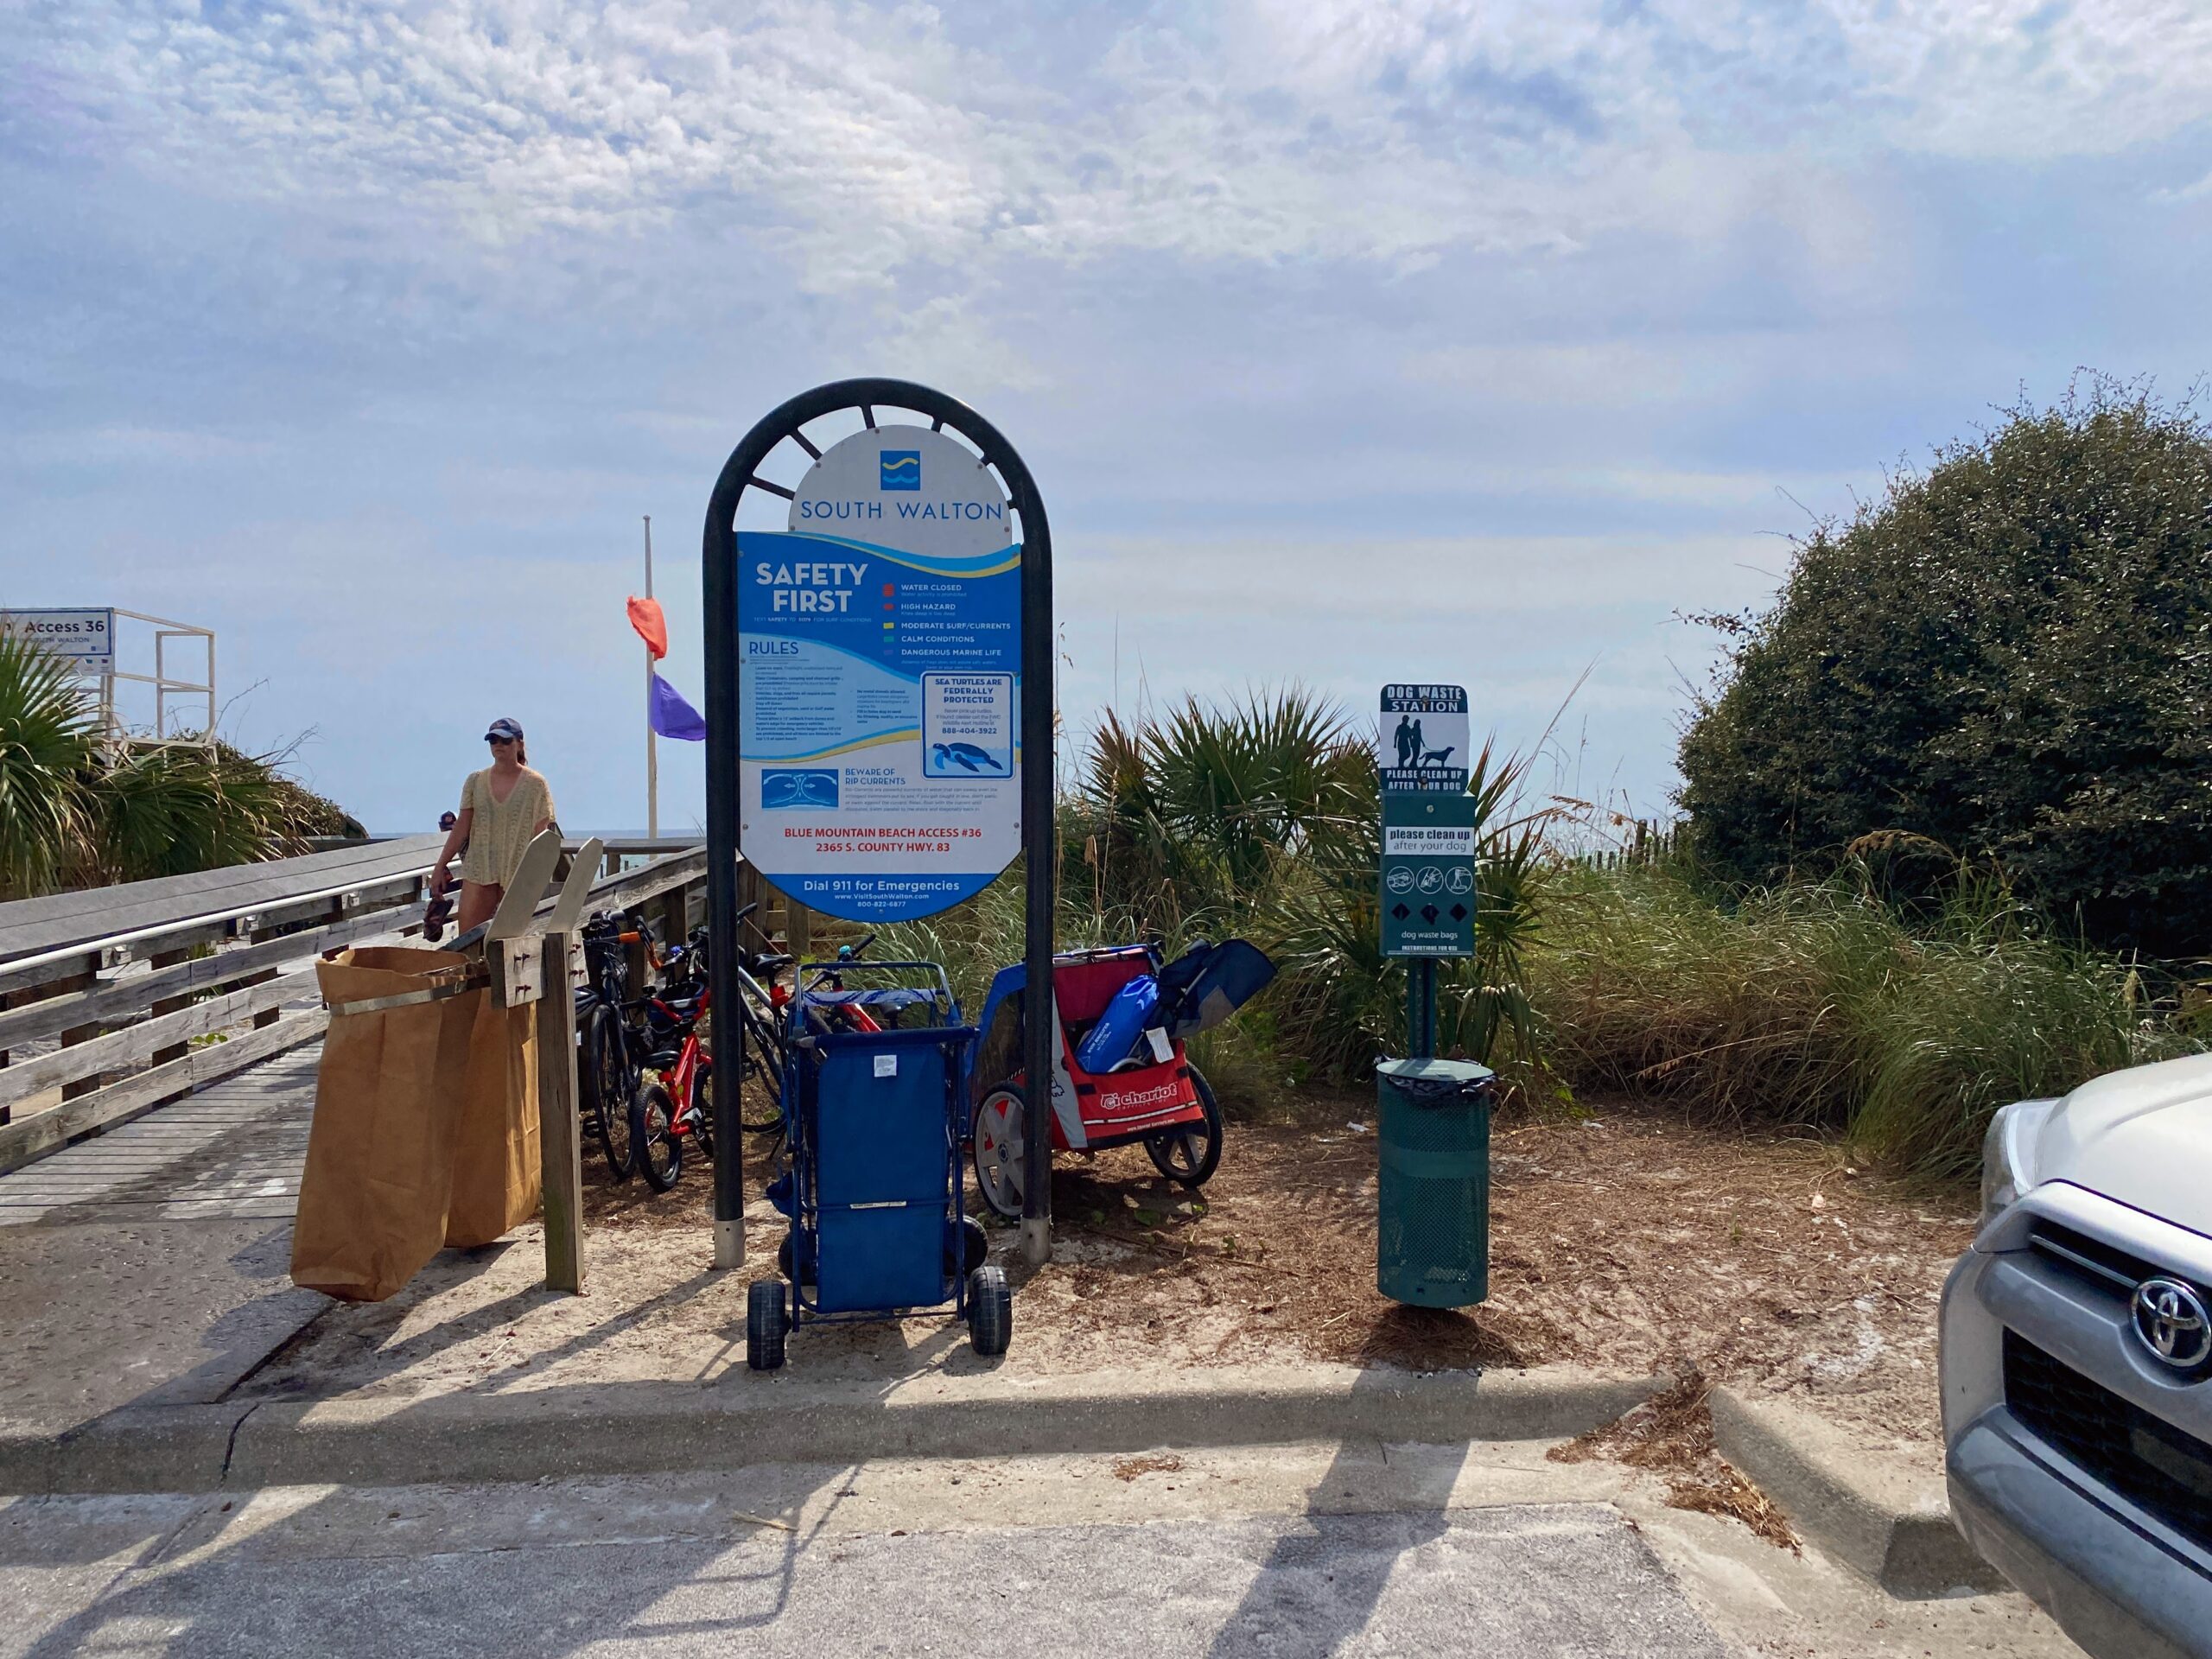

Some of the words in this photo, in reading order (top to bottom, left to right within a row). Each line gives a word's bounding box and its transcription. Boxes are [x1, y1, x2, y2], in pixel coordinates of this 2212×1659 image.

[801, 501, 881, 518] SOUTH
[897, 502, 1001, 519] WALTON
[756, 563, 868, 585] SAFETY
[774, 590, 852, 612] FIRST
[25, 622, 79, 632] Access
[86, 620, 105, 632] 36
[750, 642, 798, 654] RULES
[1388, 686, 1413, 698] DOG
[1419, 687, 1461, 700] WASTE
[1392, 701, 1458, 712] STATION
[1389, 781, 1414, 790] AFTER
[962, 829, 982, 837] #36
[1390, 830, 1424, 840] please
[1427, 830, 1454, 839] clean
[1458, 831, 1470, 840] up
[1394, 841, 1417, 849] after
[1421, 842, 1443, 852] your
[1446, 841, 1466, 852] dog
[804, 880, 828, 891] Dial
[833, 880, 850, 891] 911
[855, 880, 874, 891] for
[878, 880, 959, 892] Emergencies
[1402, 931, 1416, 940] dog
[1440, 931, 1458, 940] bags
[1122, 1083, 1177, 1105] chariot
